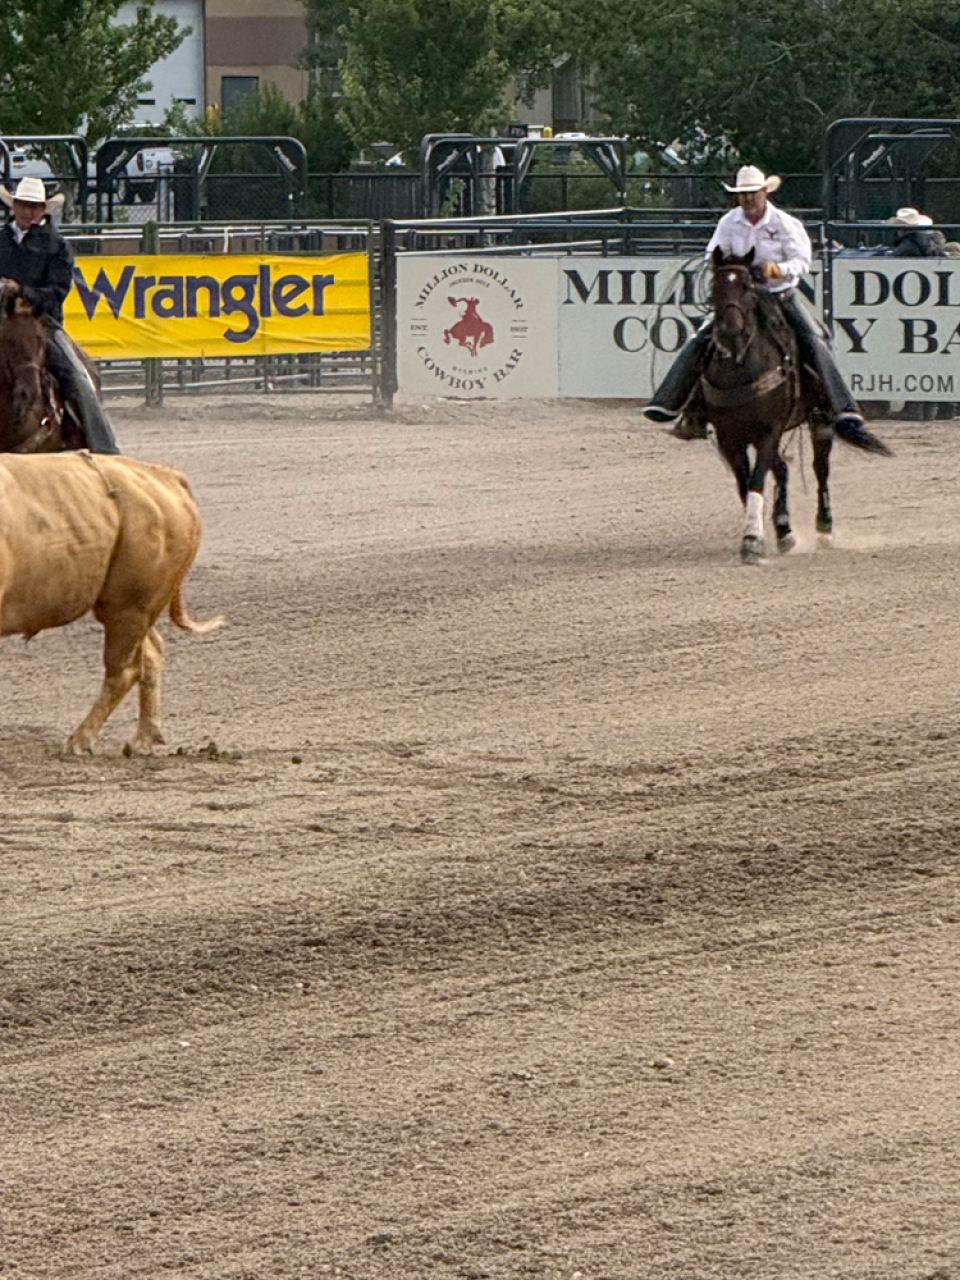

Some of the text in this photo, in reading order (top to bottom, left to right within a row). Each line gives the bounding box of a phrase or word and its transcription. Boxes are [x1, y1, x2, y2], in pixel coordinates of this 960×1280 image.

[72, 264, 335, 344] Wrangler
[415, 263, 525, 309] MILLION DOLLAR
[562, 269, 821, 306] MILLN
[417, 346, 524, 391] COWBOY BAR
